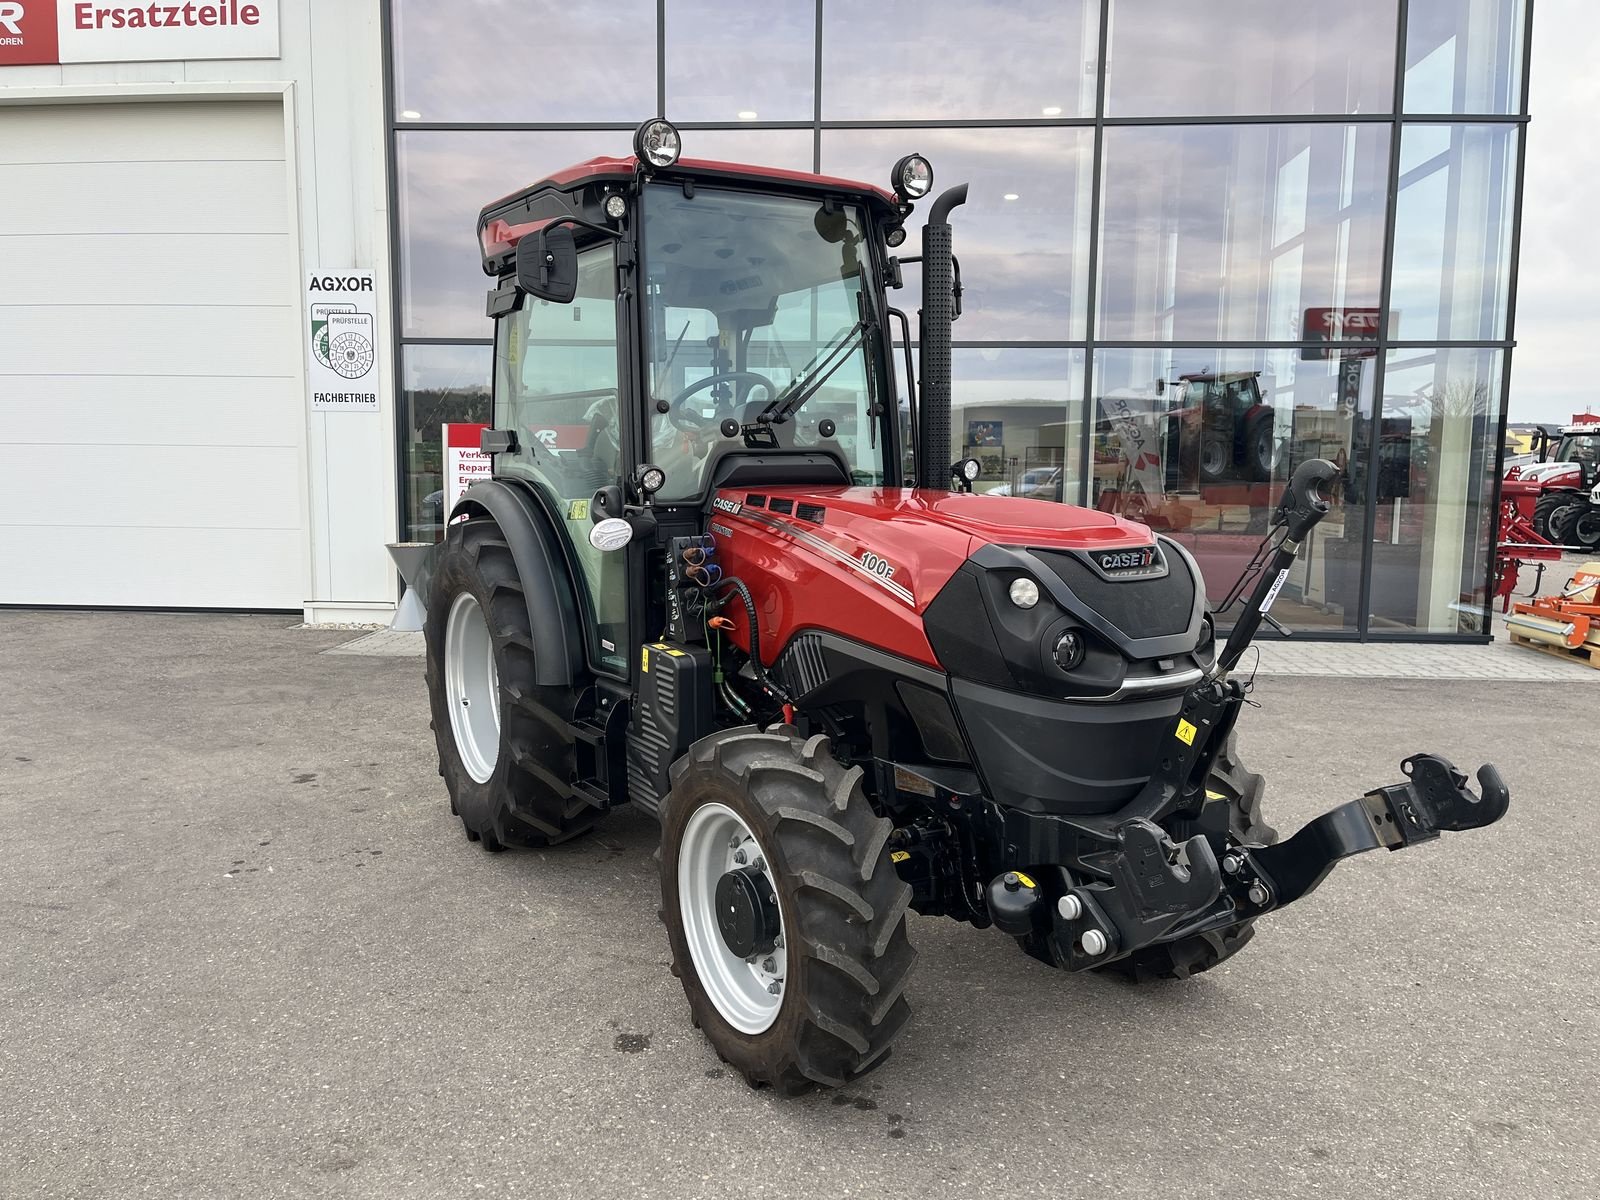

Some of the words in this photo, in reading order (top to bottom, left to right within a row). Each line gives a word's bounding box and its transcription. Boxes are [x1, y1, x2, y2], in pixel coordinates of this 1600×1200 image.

[75, 0, 260, 30] Ersatzteile
[0, 37, 24, 46] OREN
[309, 276, 373, 292] AGXOR
[332, 317, 368, 325] PRÜFSTELLE
[314, 392, 376, 403] FACHBETRIEB
[713, 497, 735, 512] CASE
[1102, 554, 1140, 569] CASE
